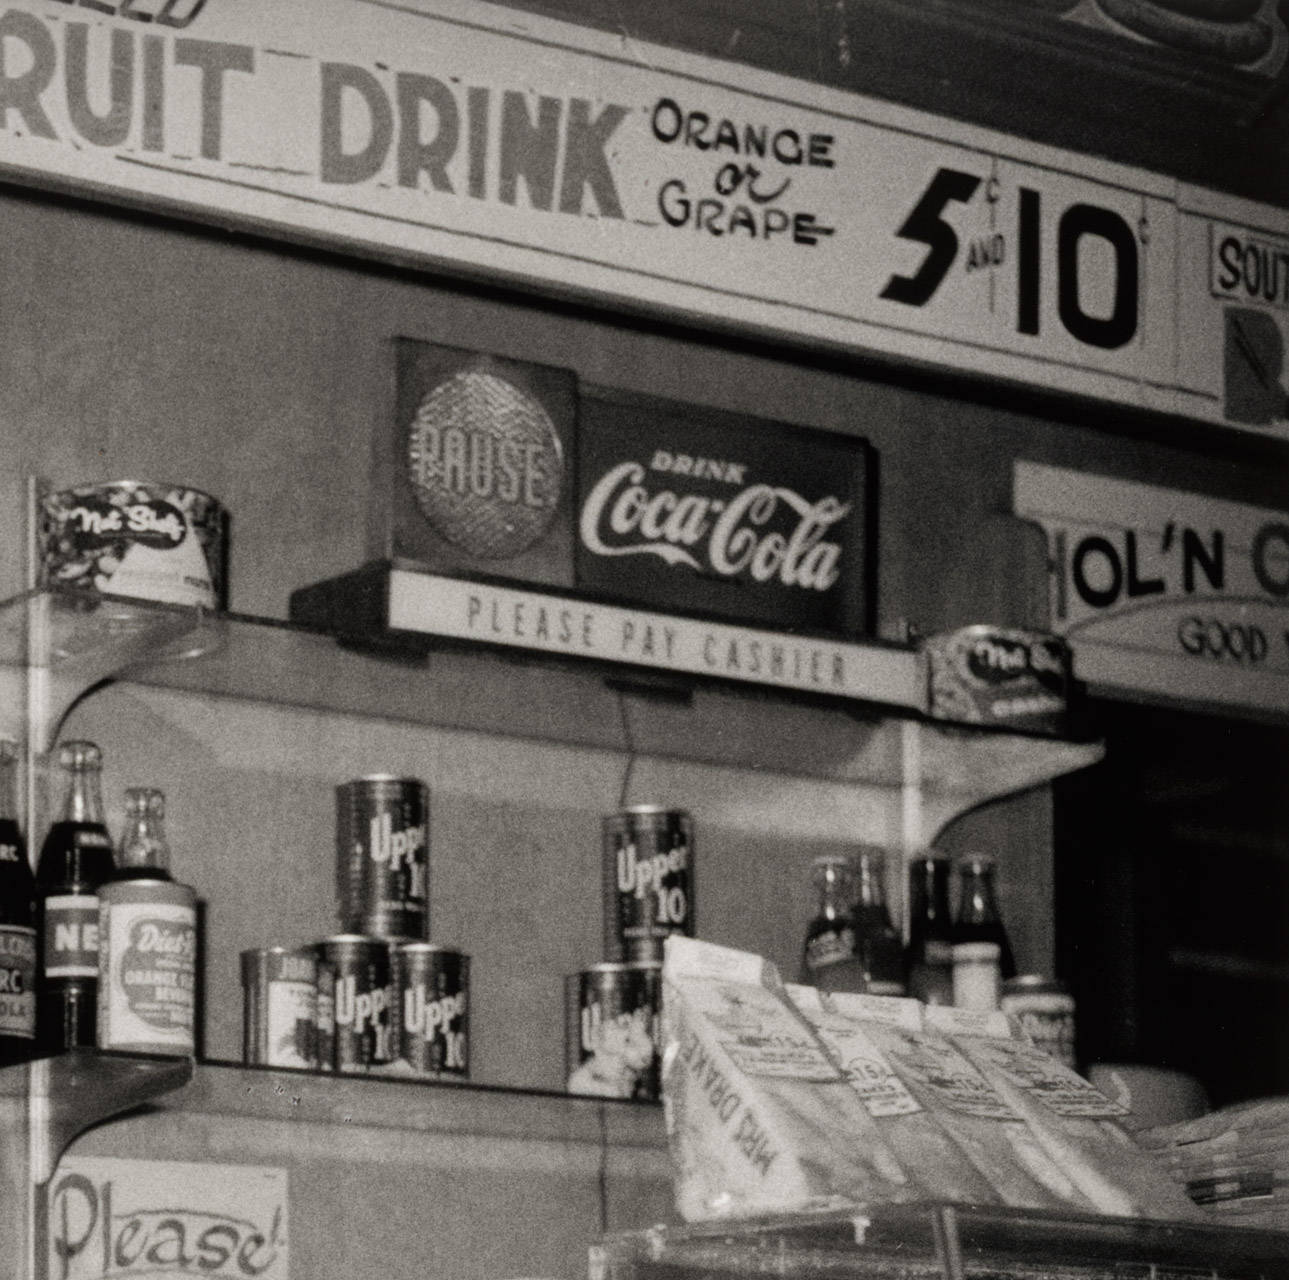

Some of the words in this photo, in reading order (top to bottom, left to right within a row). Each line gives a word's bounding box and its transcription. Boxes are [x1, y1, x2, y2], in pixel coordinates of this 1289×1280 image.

[320, 61, 634, 220] DRINK
[652, 98, 835, 169] ORANGE
[657, 179, 836, 245] GRAPE
[715, 162, 791, 203] or
[412, 423, 546, 507] PAUSE
[650, 449, 748, 485] DRINK
[579, 460, 853, 591] Coca-Cola
[467, 595, 594, 649] PLEASE
[621, 610, 677, 661] PAY
[702, 635, 846, 688] CASHIER
[1177, 614, 1268, 663] GOOD
[617, 844, 687, 900] Upper
[656, 886, 687, 924] 10
